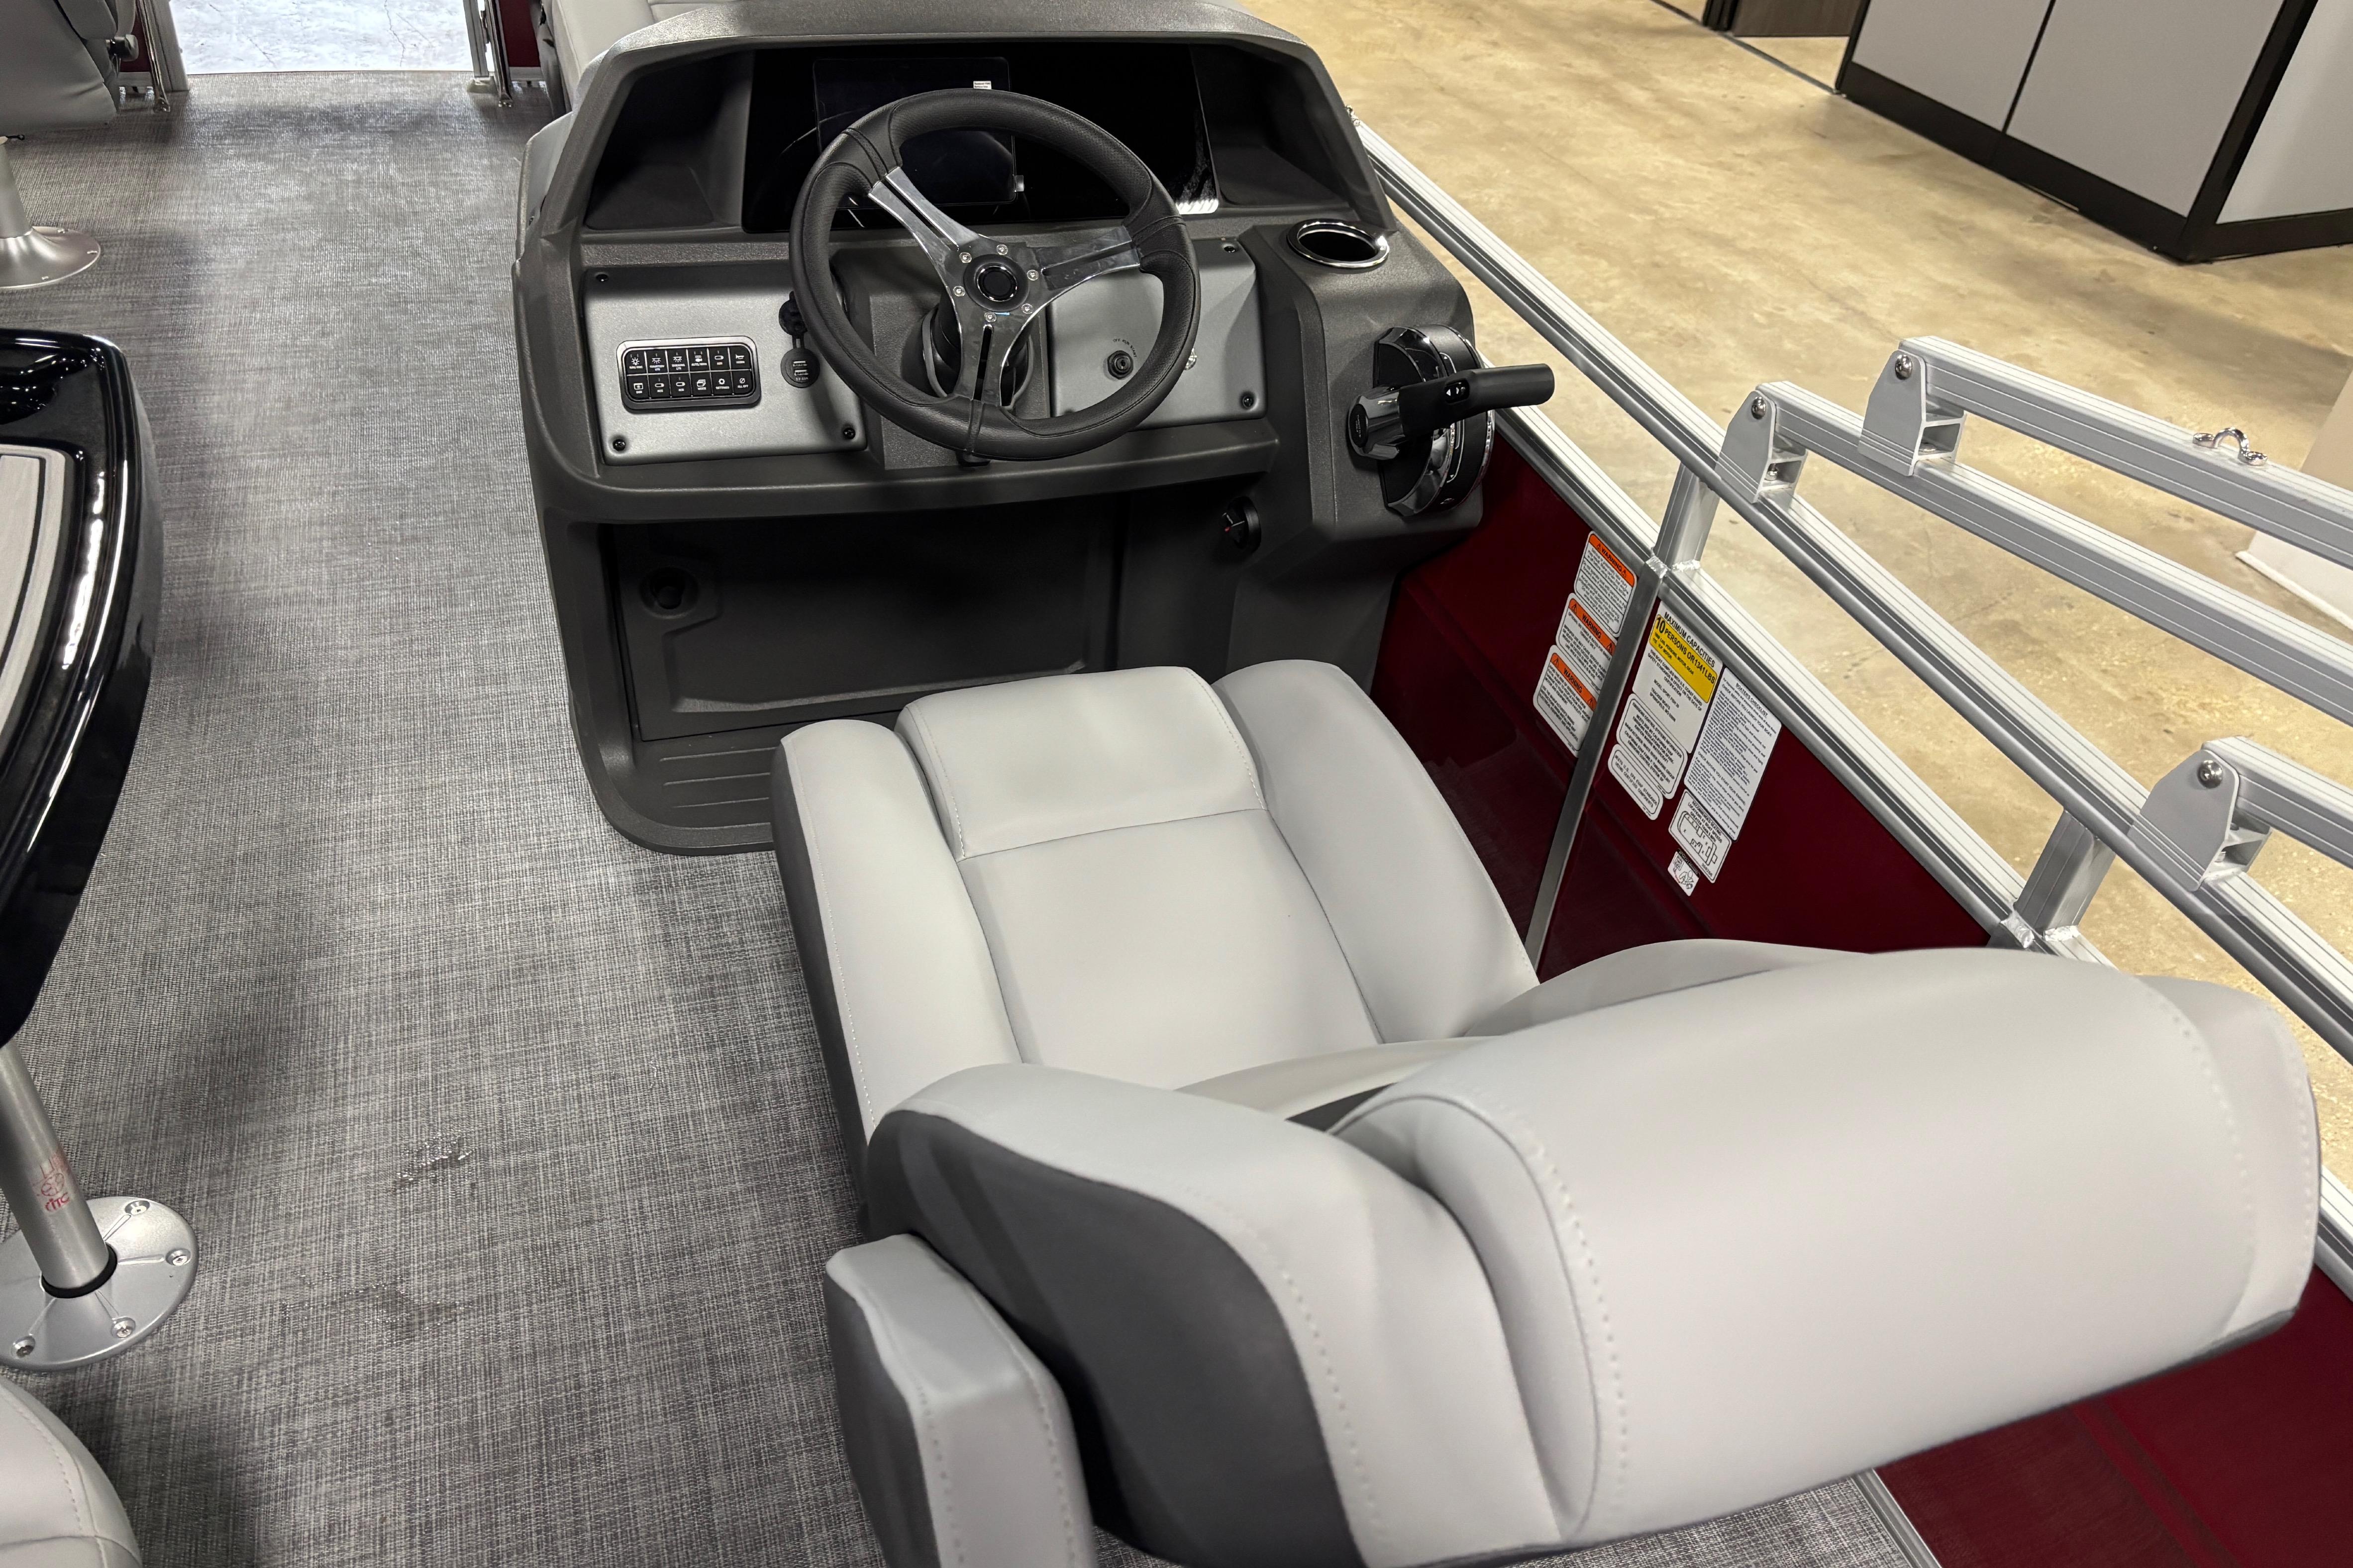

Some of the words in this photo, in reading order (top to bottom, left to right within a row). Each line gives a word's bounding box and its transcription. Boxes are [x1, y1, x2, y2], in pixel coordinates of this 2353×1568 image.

[1600, 547, 1623, 572] WARNING
[1581, 613, 1602, 639] WARNING
[1654, 614, 1666, 635] 10
[1664, 627, 1687, 655] PERSONS
[1686, 651, 1695, 664] OR
[1694, 659, 1705, 674] 1341
[1704, 669, 1715, 685] LBS
[1663, 611, 1687, 639] MAXIMUM
[1686, 634, 1716, 668] CAPACITIES
[1563, 667, 1582, 693] WARNING
[1749, 696, 1768, 718] CHECKLIST
